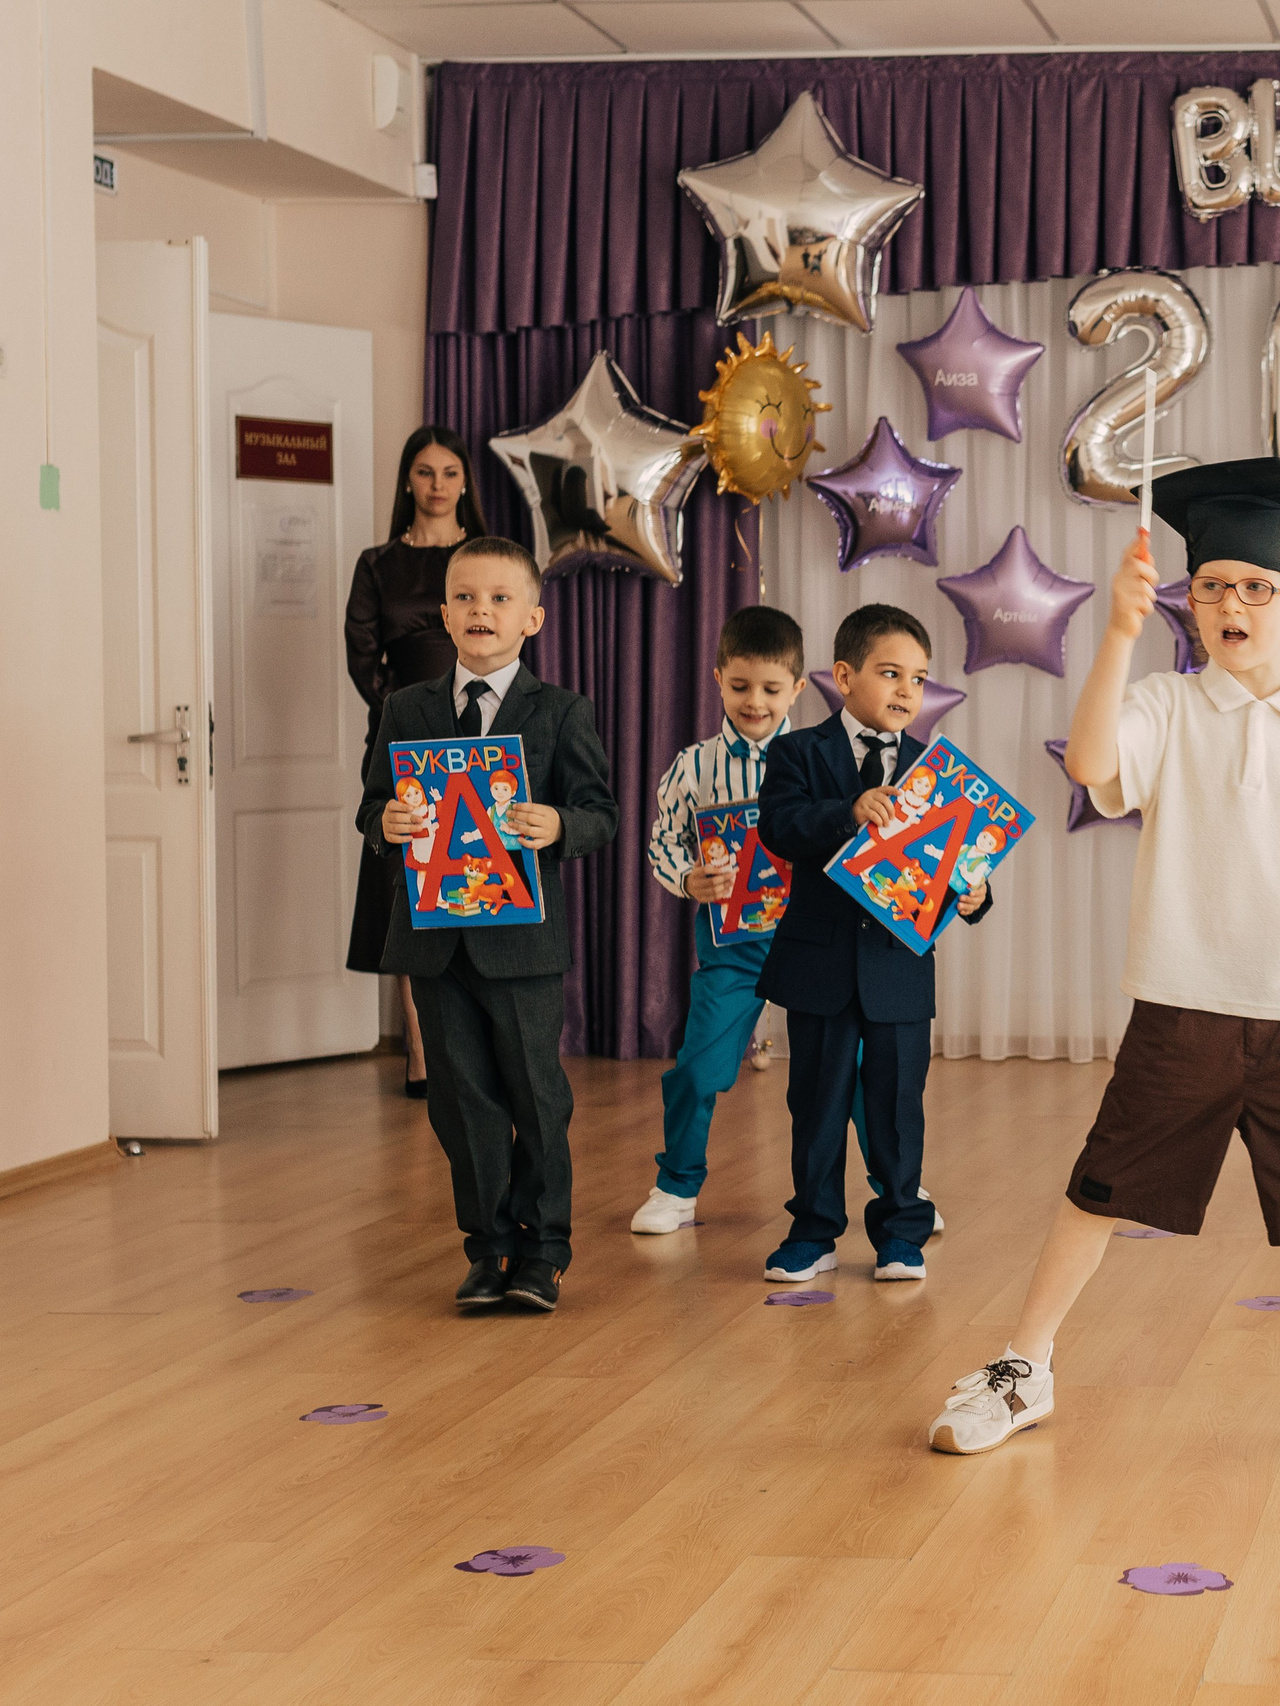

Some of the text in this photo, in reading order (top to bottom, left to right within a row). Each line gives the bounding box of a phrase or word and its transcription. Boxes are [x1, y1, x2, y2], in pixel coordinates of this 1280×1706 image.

[934, 369, 979, 387] Аиза
[244, 431, 327, 451] МУЗЫКАЛЬНЫЙ
[275, 451, 297, 466] ЗАЛ
[393, 745, 521, 776] БУКВАРЬ
[925, 743, 1024, 840] БУКВАРЬ
[698, 808, 761, 839] БУКВ
